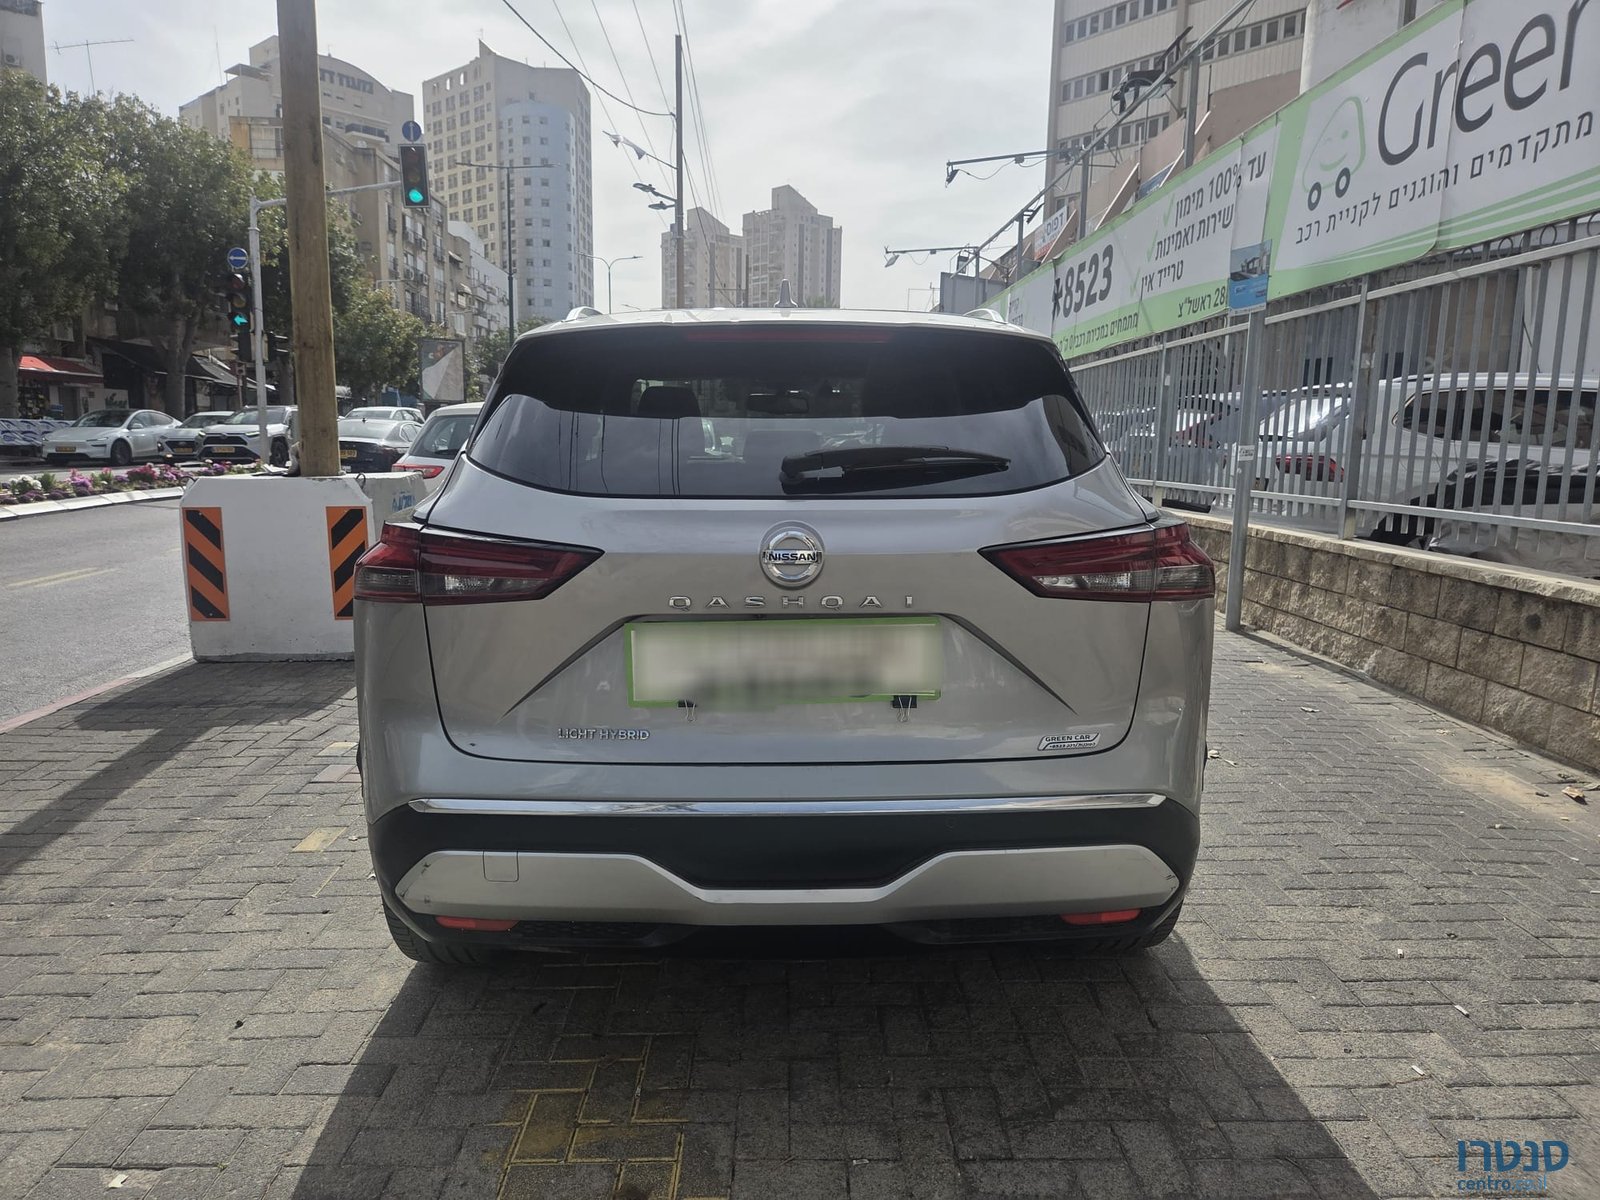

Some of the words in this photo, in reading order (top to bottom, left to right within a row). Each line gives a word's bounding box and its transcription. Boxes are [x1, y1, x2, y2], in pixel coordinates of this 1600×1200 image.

[1469, 110, 1594, 180] מתקדמים
[1247, 151, 1267, 182] עד
[1208, 163, 1242, 203] 100%
[1388, 163, 1460, 210] והוגנים
[1174, 187, 1205, 228] מימון
[1196, 203, 1235, 242] שירות
[1326, 190, 1382, 233] לקניית
[1154, 223, 1196, 261] ואמינות
[1294, 219, 1322, 245] רכב
[1139, 272, 1155, 301] אין
[1156, 259, 1185, 288] טרייד
[1177, 293, 1212, 319] ראשל"צ
[1109, 311, 1140, 336] מתמחים
[768, 552, 817, 562] NISSAN
[667, 594, 917, 613] QASHQAI
[557, 727, 597, 740] LIGHT
[599, 728, 651, 741] HYBRID
